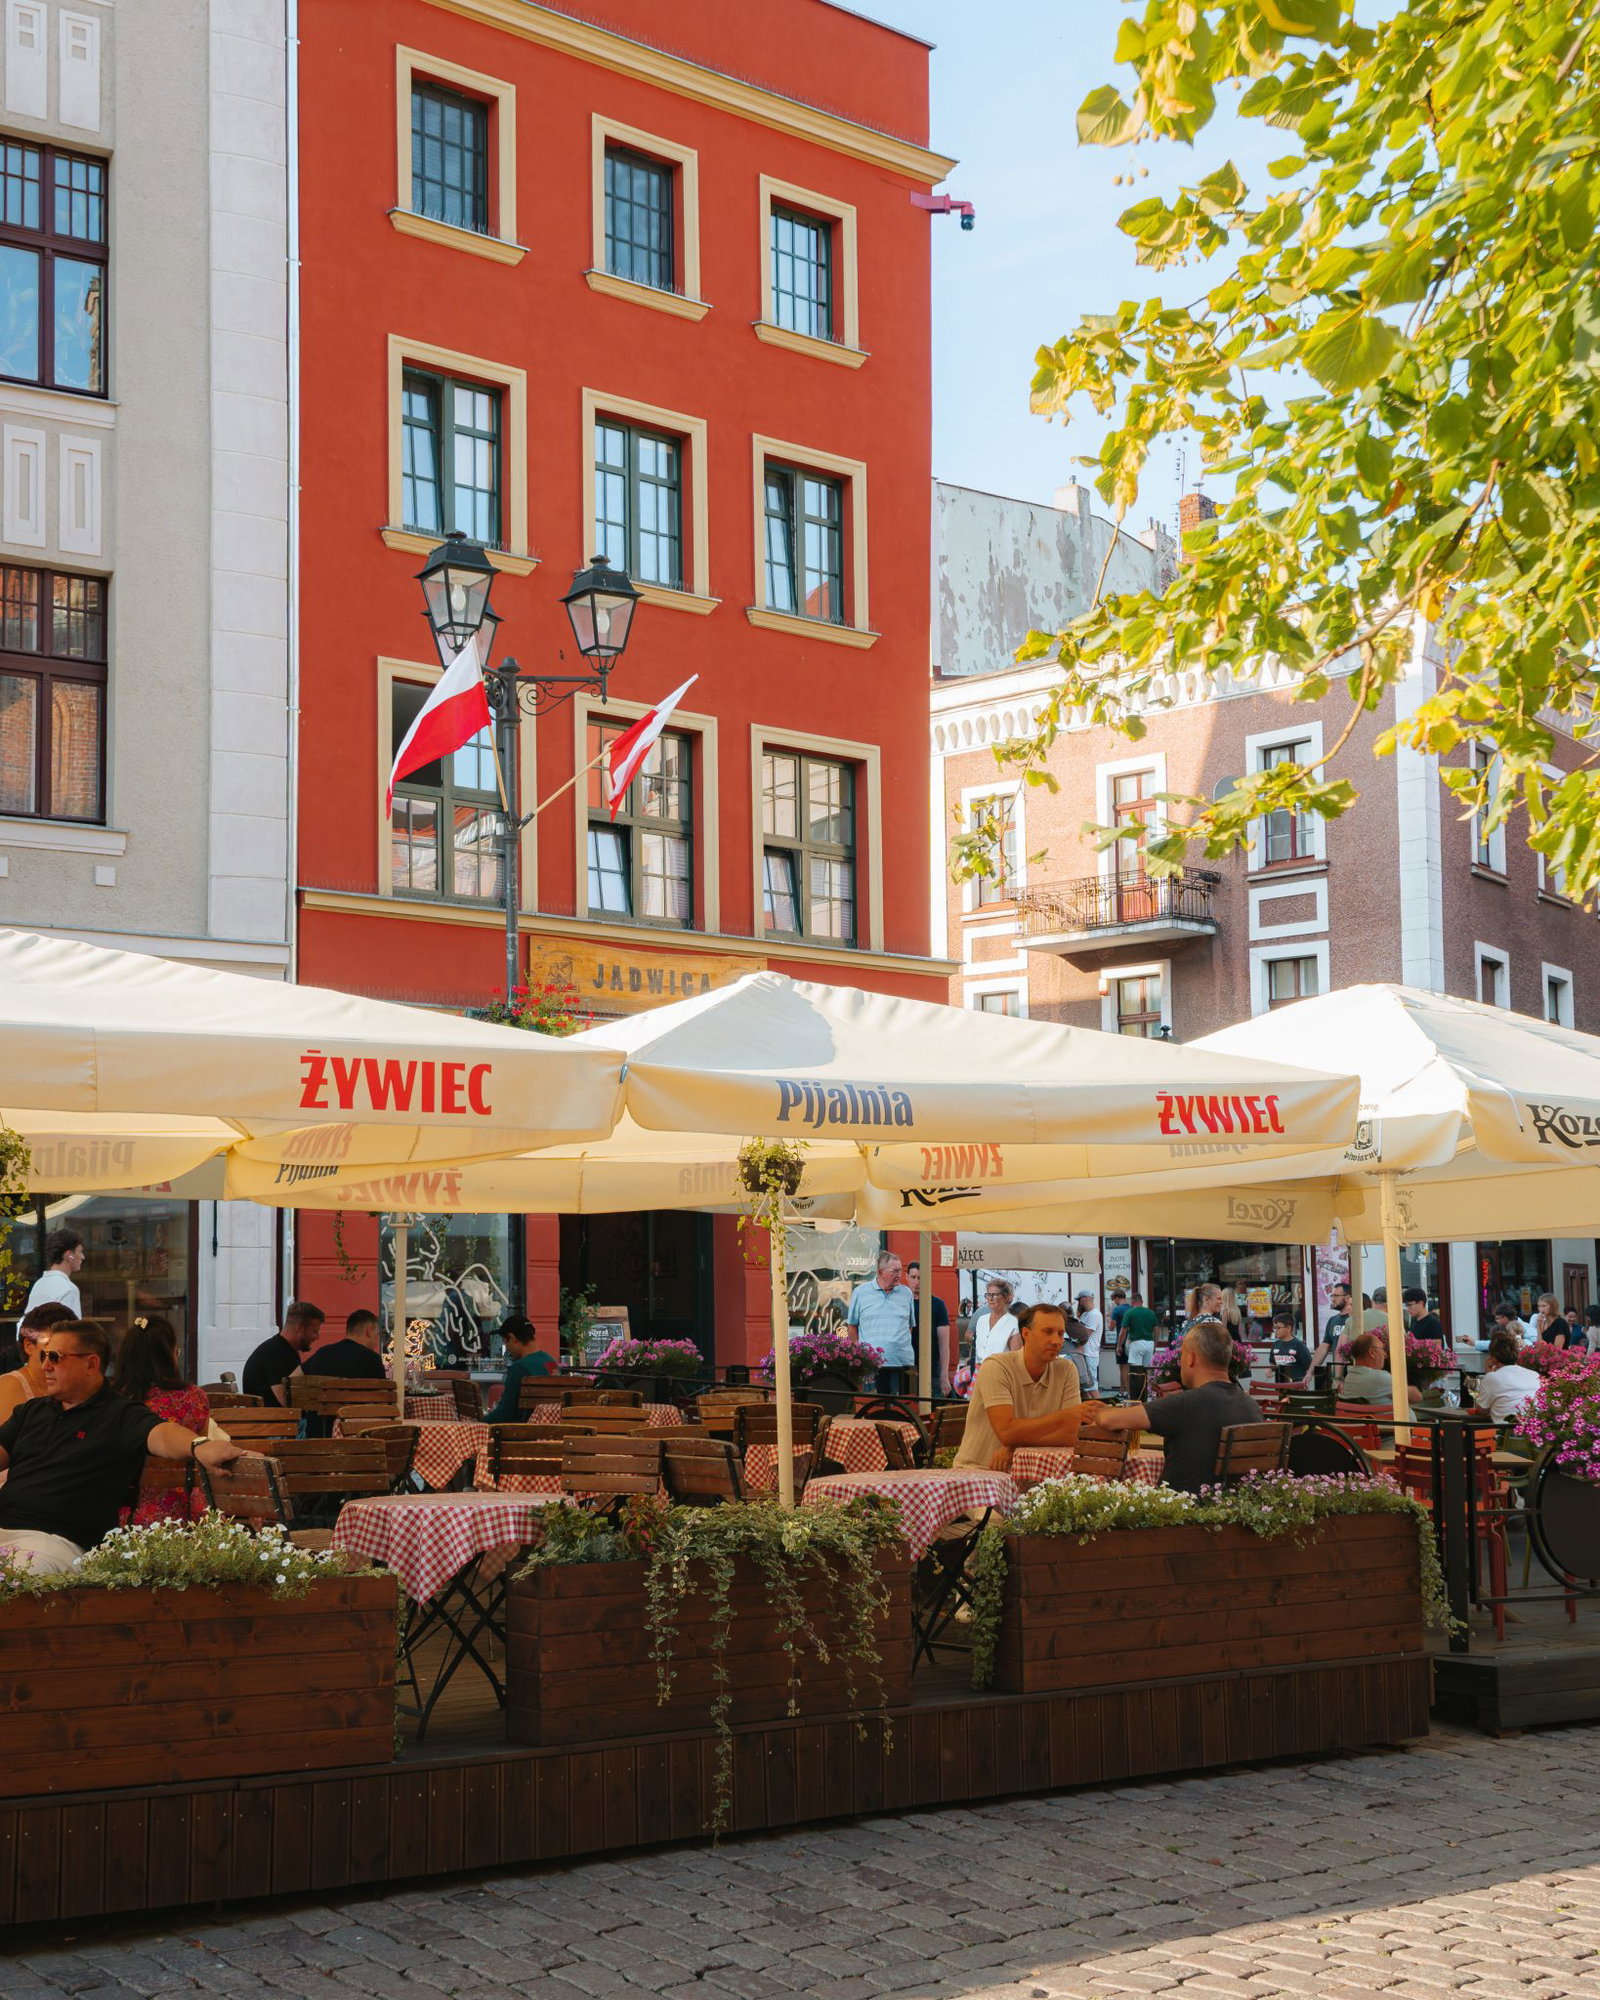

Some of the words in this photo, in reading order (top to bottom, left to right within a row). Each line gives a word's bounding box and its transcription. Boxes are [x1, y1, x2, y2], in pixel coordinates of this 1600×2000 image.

[593, 963, 711, 996] JADWIGA
[299, 1049, 493, 1116] ŻYWIEC
[775, 1079, 914, 1130] Pijalnia
[1155, 1090, 1286, 1135] ŻYWIEC
[958, 1247, 985, 1265] ĄŻĘCE
